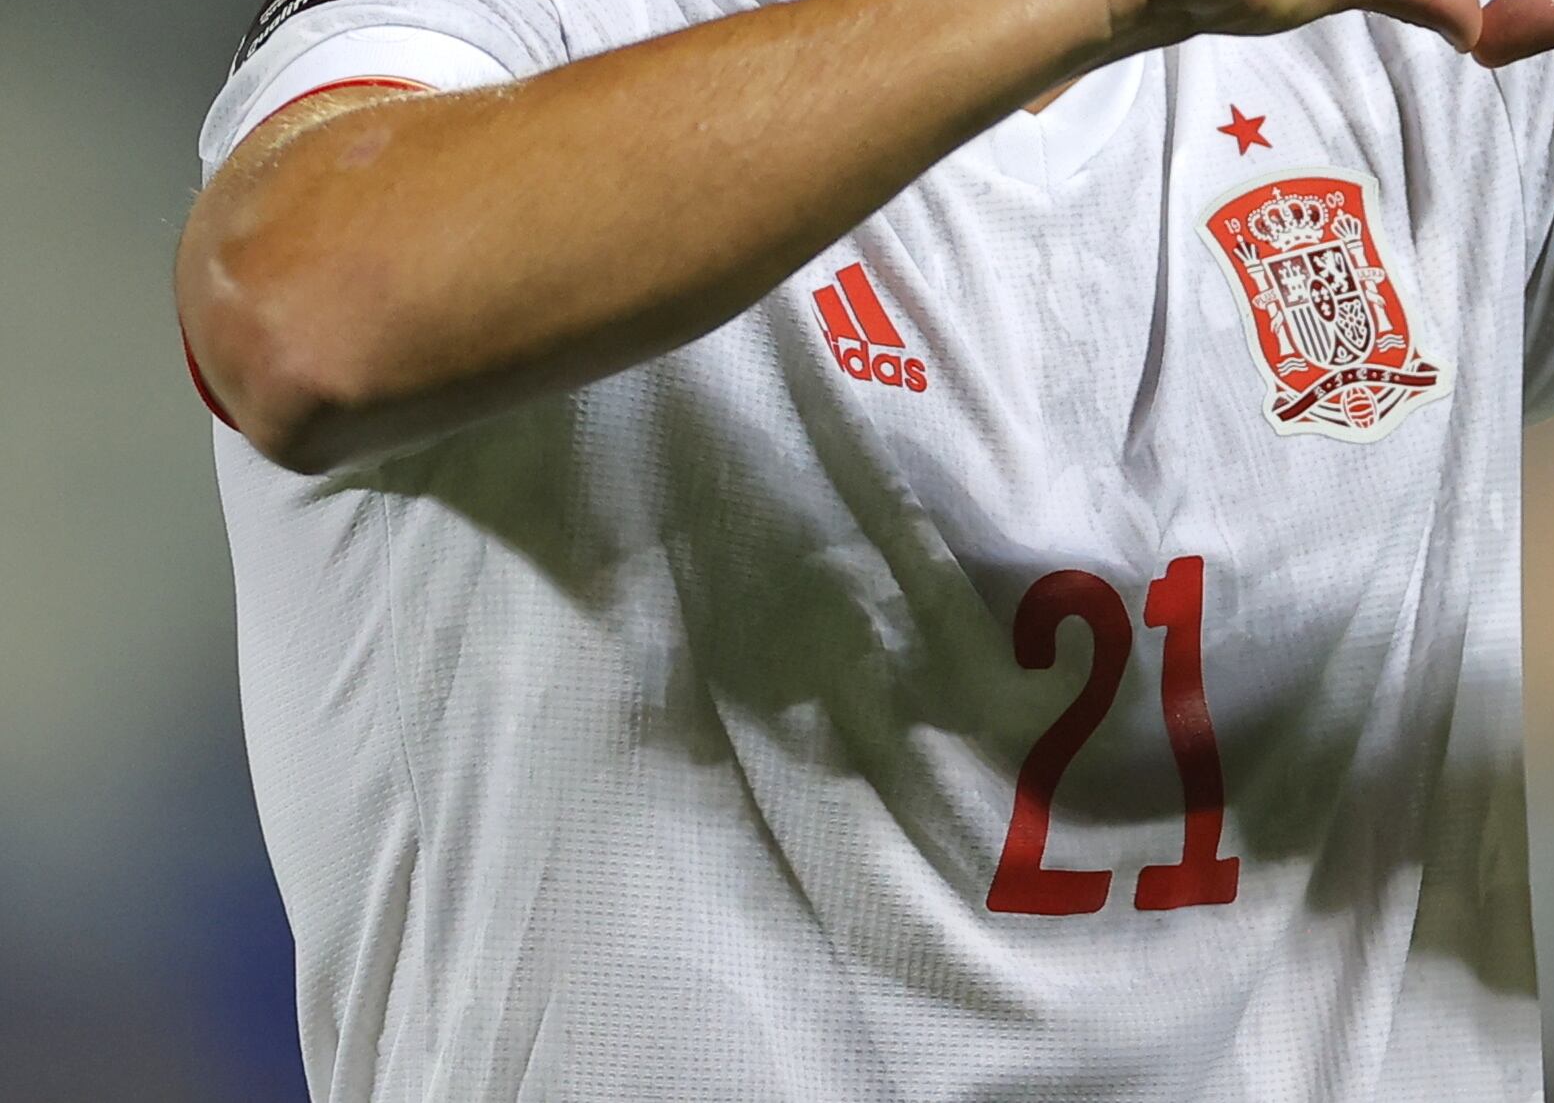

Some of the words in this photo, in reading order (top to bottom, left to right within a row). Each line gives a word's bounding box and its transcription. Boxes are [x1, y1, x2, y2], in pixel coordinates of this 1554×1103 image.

[1224, 218, 1241, 235] 19
[824, 331, 928, 393] idas
[986, 555, 1240, 916] 21
